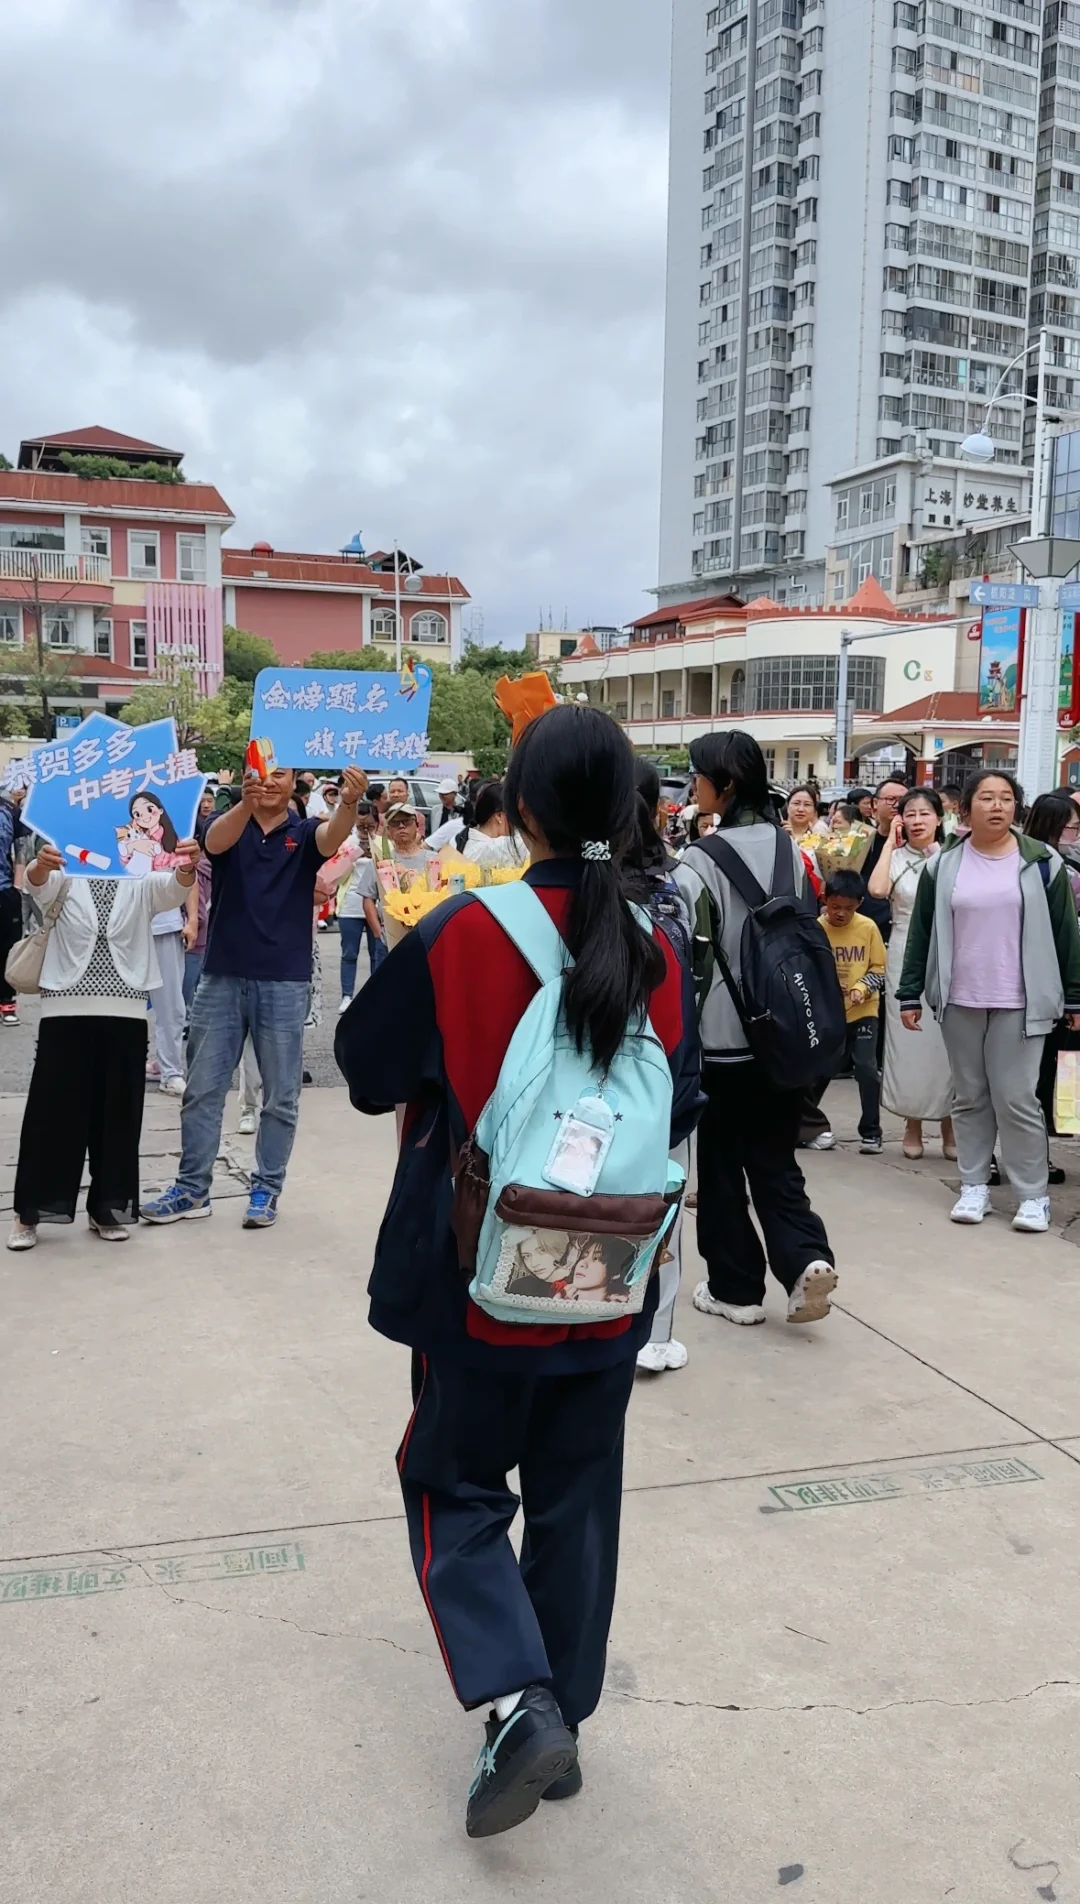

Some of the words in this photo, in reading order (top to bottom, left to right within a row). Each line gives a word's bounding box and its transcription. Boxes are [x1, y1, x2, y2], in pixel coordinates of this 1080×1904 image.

[924, 487, 953, 507] 上海
[156, 642, 200, 657] RAIN
[261, 679, 389, 714] 金榜题名
[3, 728, 137, 793] 恭贺多多
[304, 726, 432, 761] 旗开得胜
[67, 748, 200, 810] 中考大捷
[832, 945, 866, 962] RVM
[793, 972, 812, 1018] AIYAYO
[806, 1021, 820, 1048] BAG
